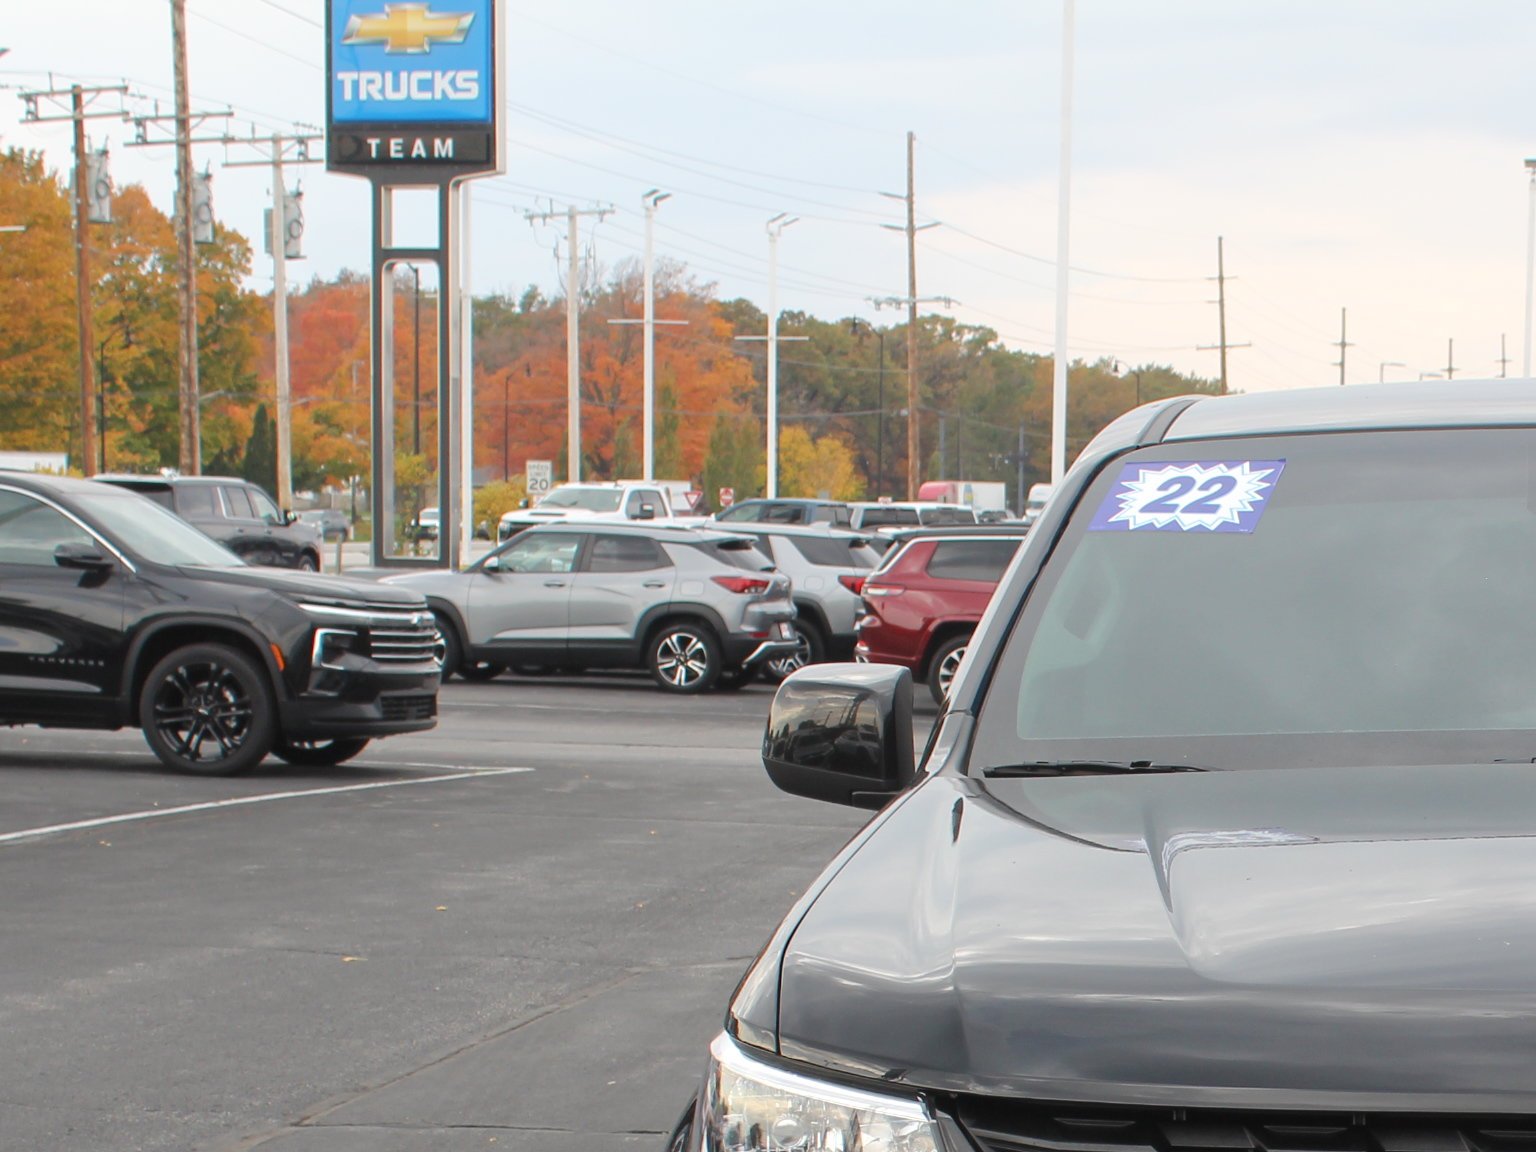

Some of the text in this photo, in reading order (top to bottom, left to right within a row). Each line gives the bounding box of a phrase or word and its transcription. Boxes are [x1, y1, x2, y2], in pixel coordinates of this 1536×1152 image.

[337, 70, 479, 101] TRUCKS
[366, 138, 454, 158] TEAM
[529, 478, 549, 491] 20
[1138, 475, 1238, 514] 22
